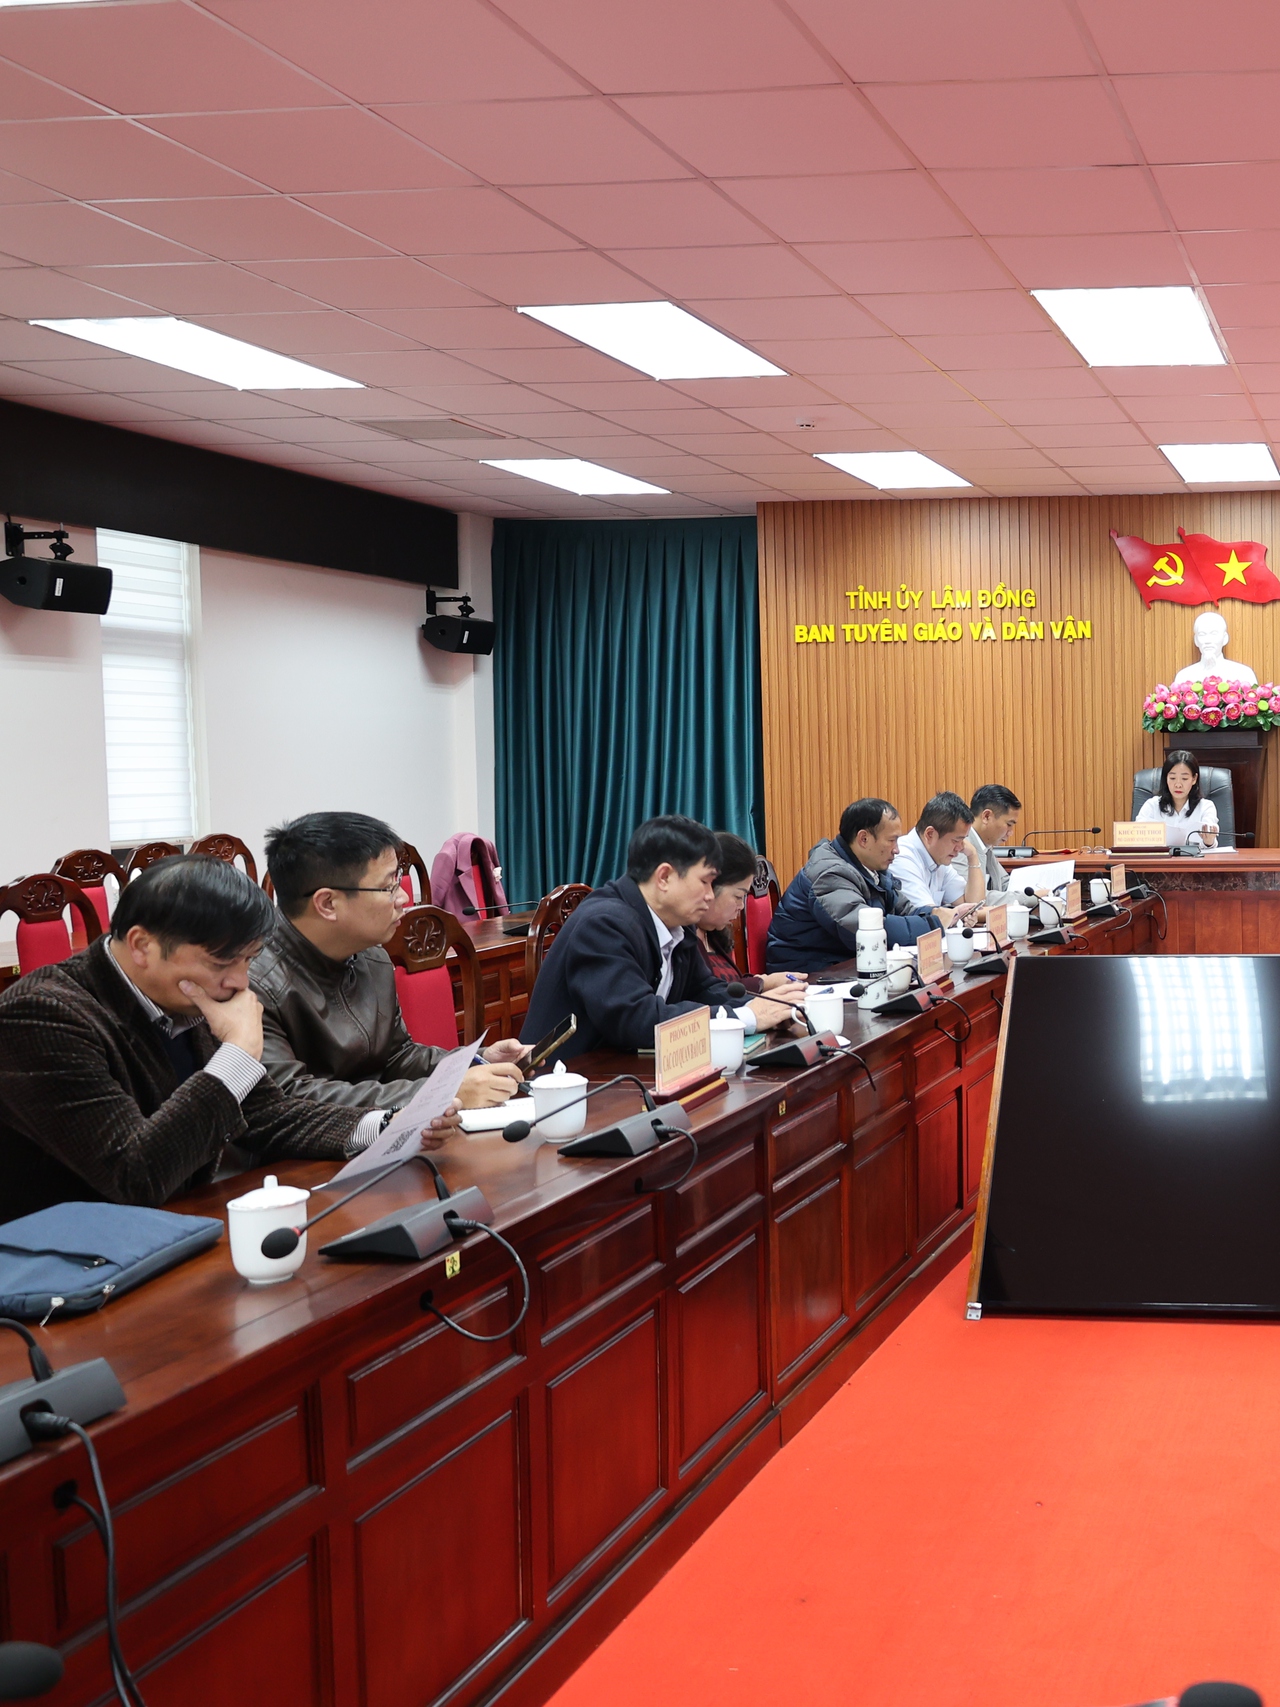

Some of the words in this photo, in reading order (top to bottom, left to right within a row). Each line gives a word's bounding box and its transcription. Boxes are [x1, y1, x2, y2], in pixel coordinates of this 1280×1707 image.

[846, 585, 891, 610] TỈNH
[895, 584, 924, 610] ỦY
[931, 584, 972, 610] LÂM
[977, 582, 1036, 609] ĐỒNG
[794, 624, 835, 643] BAN
[841, 618, 908, 643] TUYÊN
[913, 618, 963, 642] GIÁO
[968, 616, 997, 641] VÀ
[1002, 615, 1044, 641] DÂN
[1050, 615, 1092, 643] VẬN
